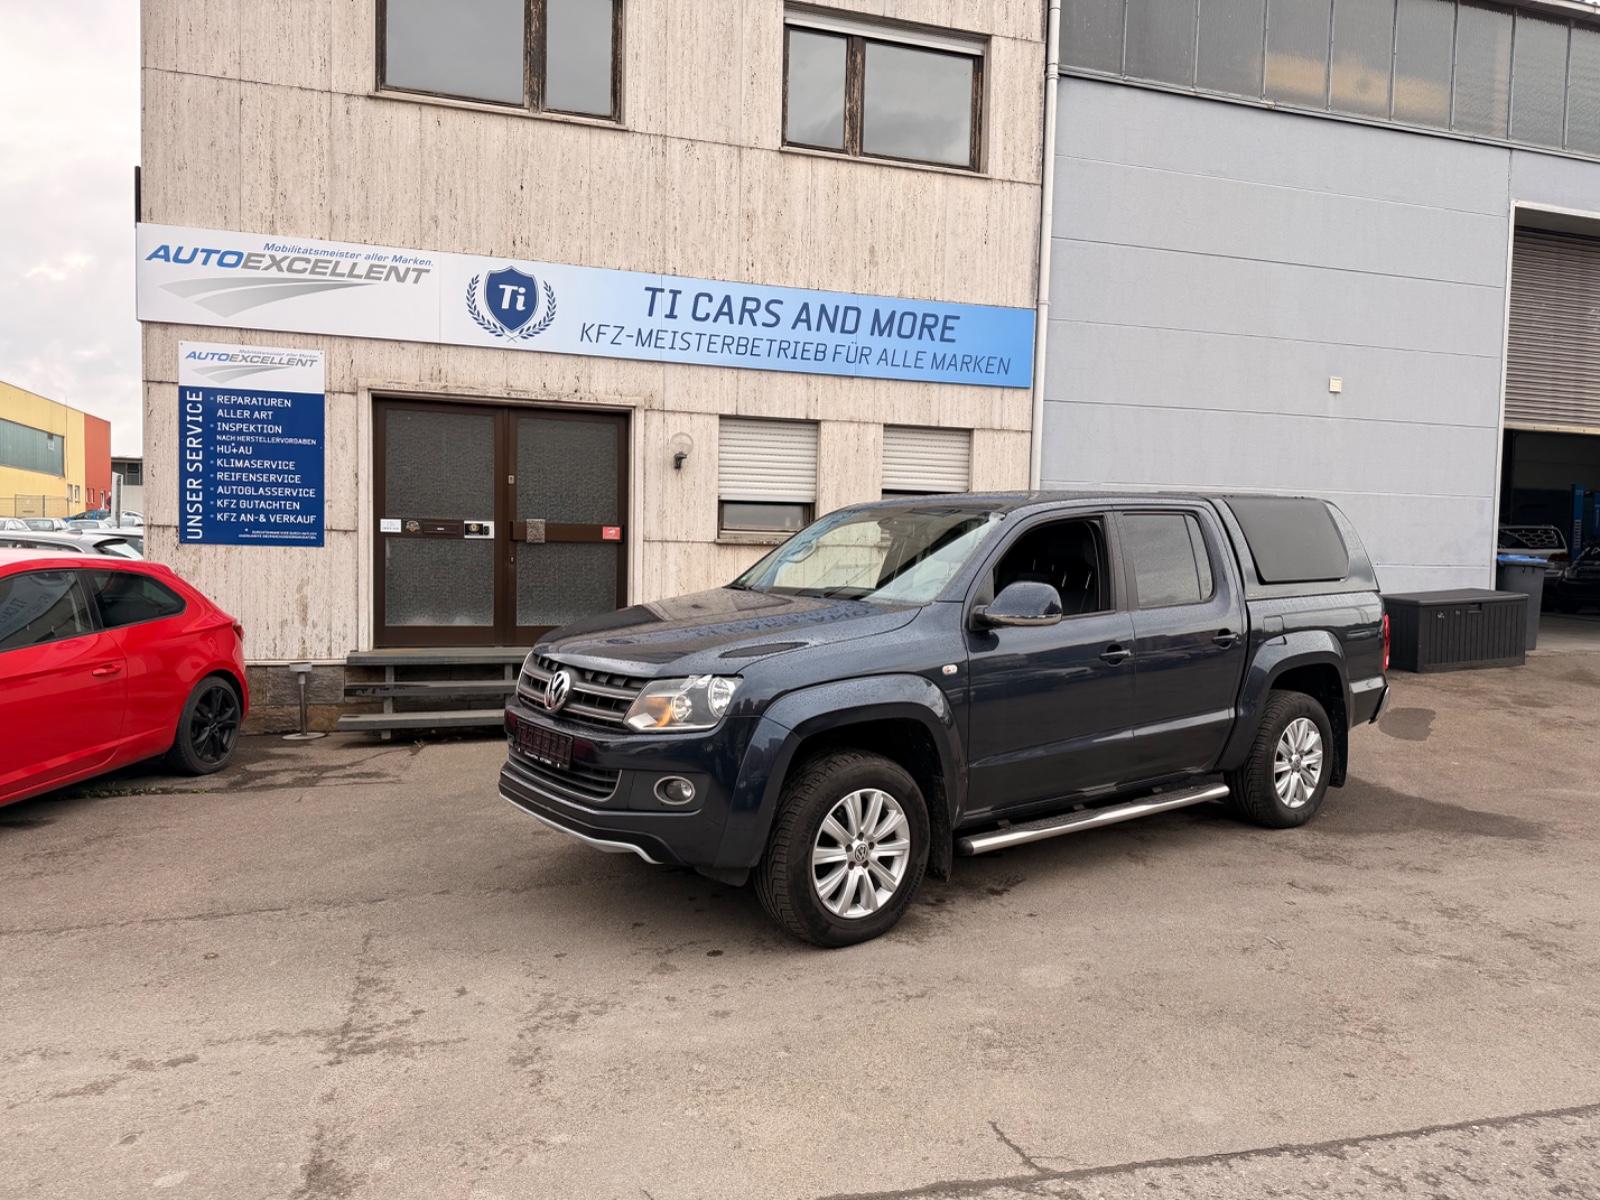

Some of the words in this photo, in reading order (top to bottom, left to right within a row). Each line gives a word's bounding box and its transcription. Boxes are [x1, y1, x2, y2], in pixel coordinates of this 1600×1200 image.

[364, 252, 389, 262] aller
[145, 244, 431, 284] AUTOEXCELLENT
[499, 284, 526, 311] Ti
[644, 286, 682, 319] TI
[691, 292, 784, 328] CARS
[791, 302, 862, 335] AND
[870, 308, 961, 343] MORE
[580, 322, 828, 361] KFZ-MEISTERBETRIEB
[832, 341, 873, 366] FÜR
[876, 348, 928, 370] ALLE
[930, 352, 1011, 376] MARKEN
[185, 351, 318, 368] AUTOEXCELLENT
[216, 395, 292, 408] REPARATUREN
[216, 409, 250, 419] ALLER
[253, 410, 273, 420] ART
[186, 391, 203, 472] SERVICE
[216, 422, 282, 434] INSPEKTION
[216, 434, 237, 442] NACH
[216, 458, 296, 470] KLIMASERVICE
[216, 471, 302, 484] REIFENSERVICE
[216, 485, 316, 498] AUTOGLASSERVICE
[186, 479, 203, 539] UNSER
[216, 499, 237, 509] KFZ
[239, 499, 300, 510] GUTACHTEN
[216, 512, 237, 522] KFZ
[269, 514, 317, 524] VERKAUF
